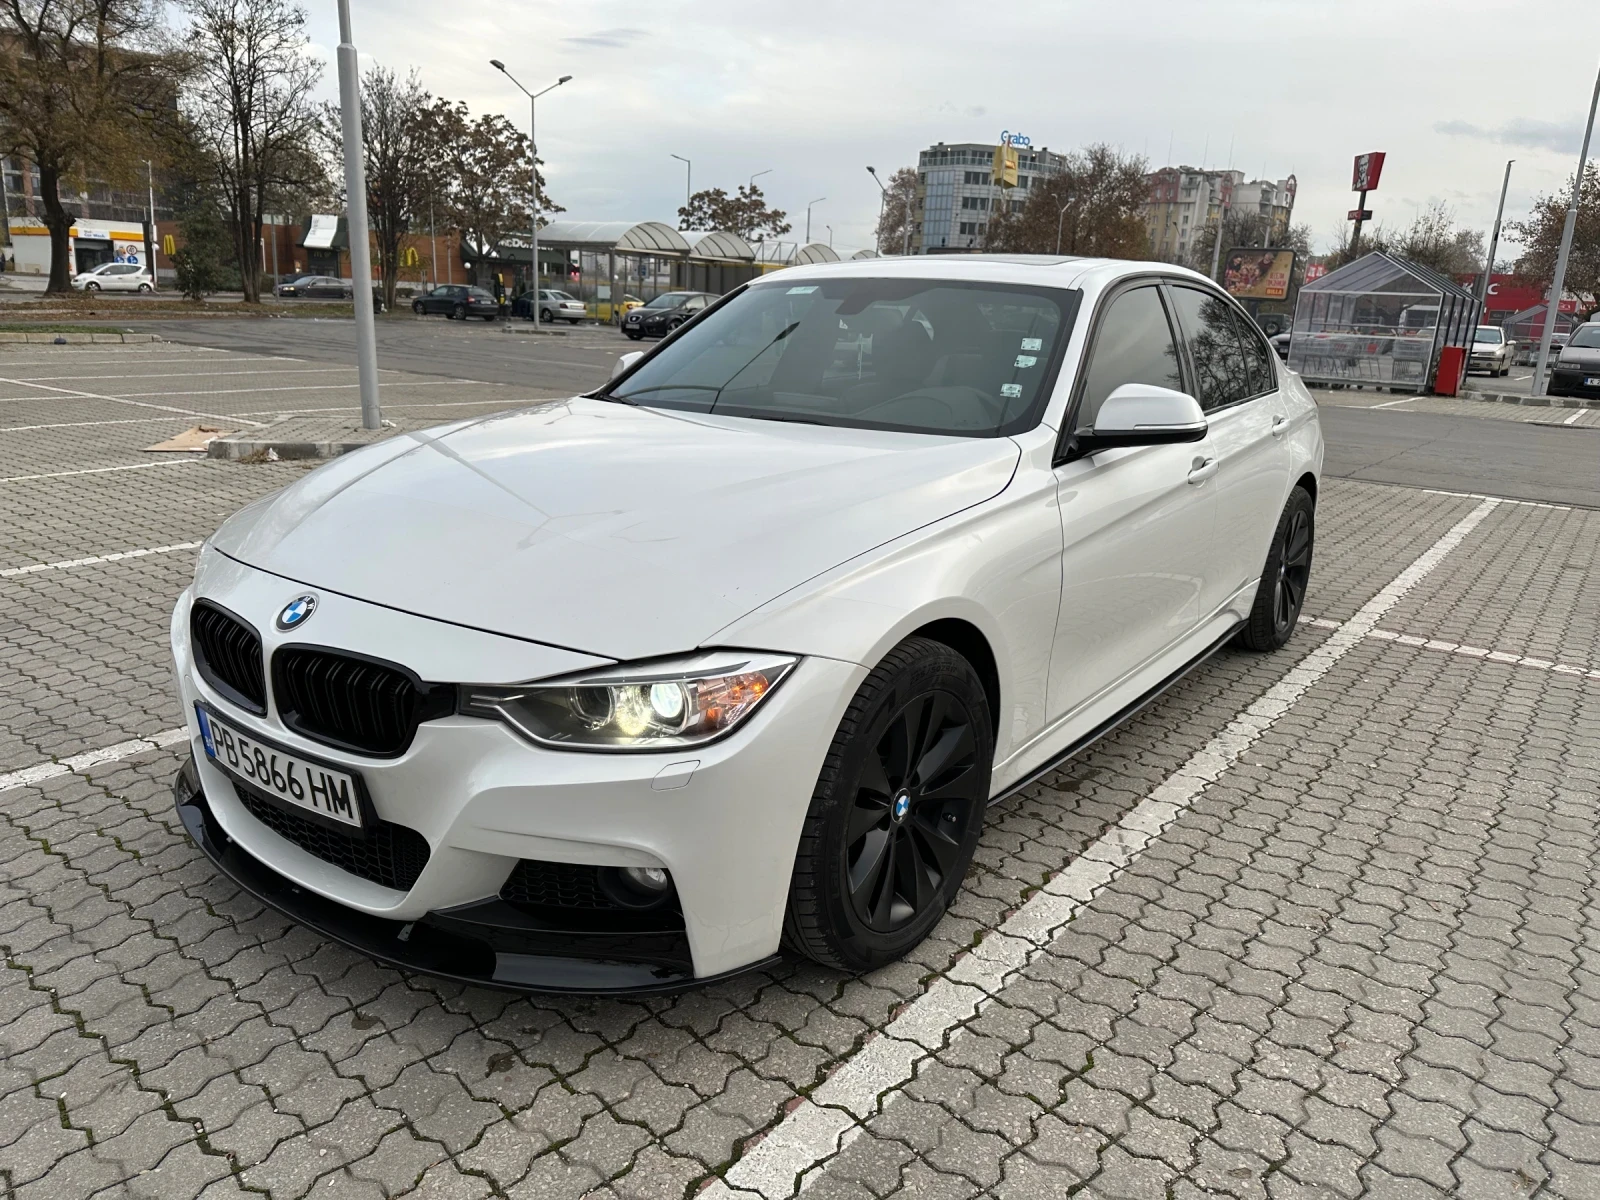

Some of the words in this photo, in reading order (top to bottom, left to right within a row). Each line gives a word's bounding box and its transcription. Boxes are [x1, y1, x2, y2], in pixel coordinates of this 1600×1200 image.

[1001, 130, 1030, 145] Grabo
[1461, 282, 1500, 295] KC
[209, 719, 239, 768] PB
[238, 737, 304, 800] 5866
[306, 767, 353, 819] HM
